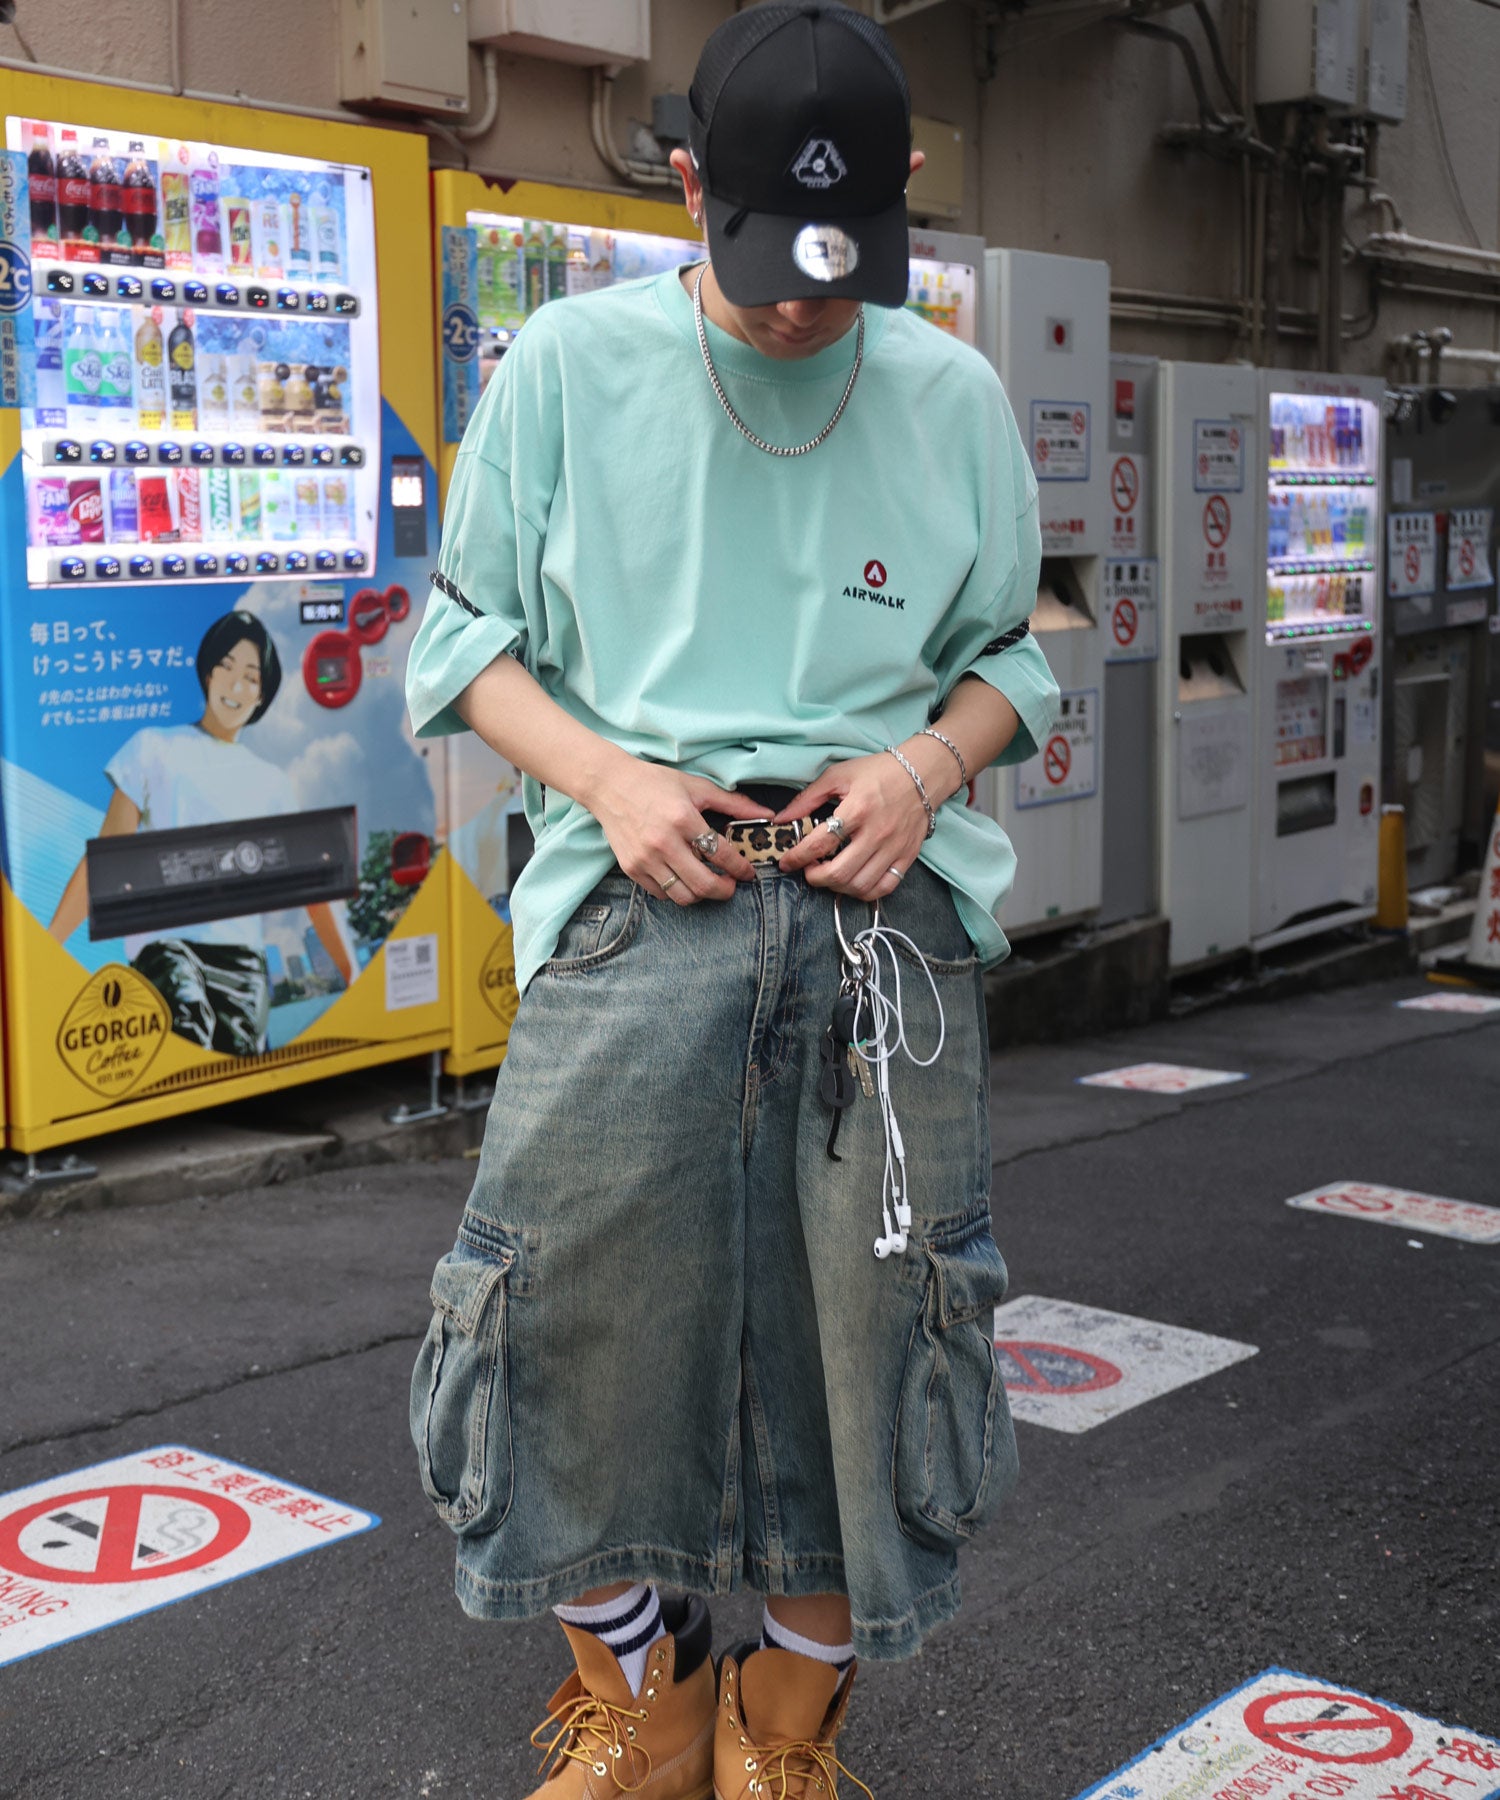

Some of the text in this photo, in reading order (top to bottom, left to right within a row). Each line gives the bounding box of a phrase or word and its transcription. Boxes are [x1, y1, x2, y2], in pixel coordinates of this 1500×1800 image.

[842, 586, 905, 611] AIRWALK
[30, 620, 117, 646] 毎日って、
[33, 646, 195, 676] けっこうドラマだ。
[64, 1013, 160, 1051] GEORGIA
[86, 1042, 142, 1075] Coffee
[141, 1450, 355, 1533] 路上喫煙禁止
